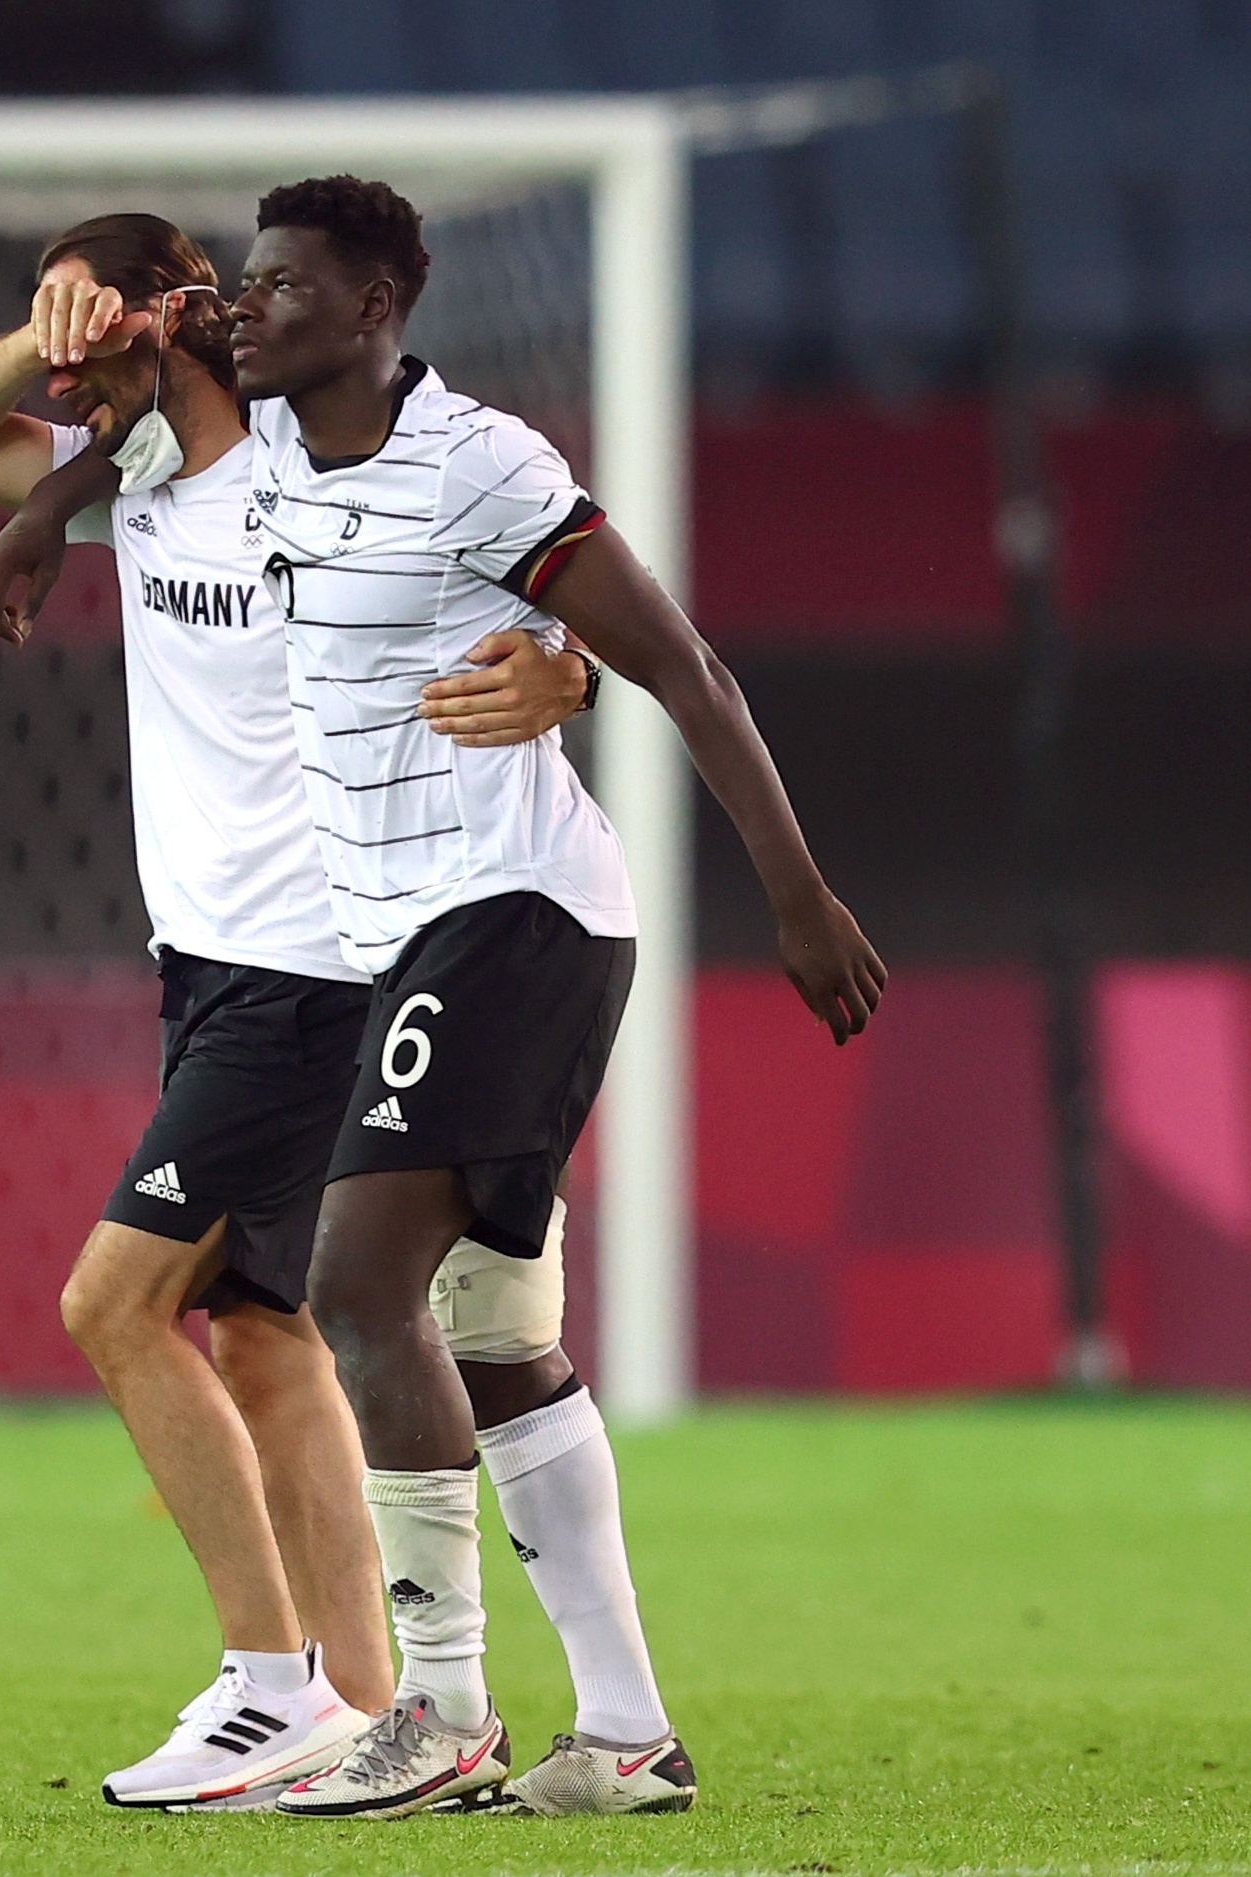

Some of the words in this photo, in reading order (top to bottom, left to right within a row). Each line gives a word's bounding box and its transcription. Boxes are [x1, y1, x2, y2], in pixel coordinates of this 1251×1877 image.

[381, 993, 444, 1089] 6
[361, 1115, 409, 1132] adidas
[135, 1180, 187, 1204] adidas
